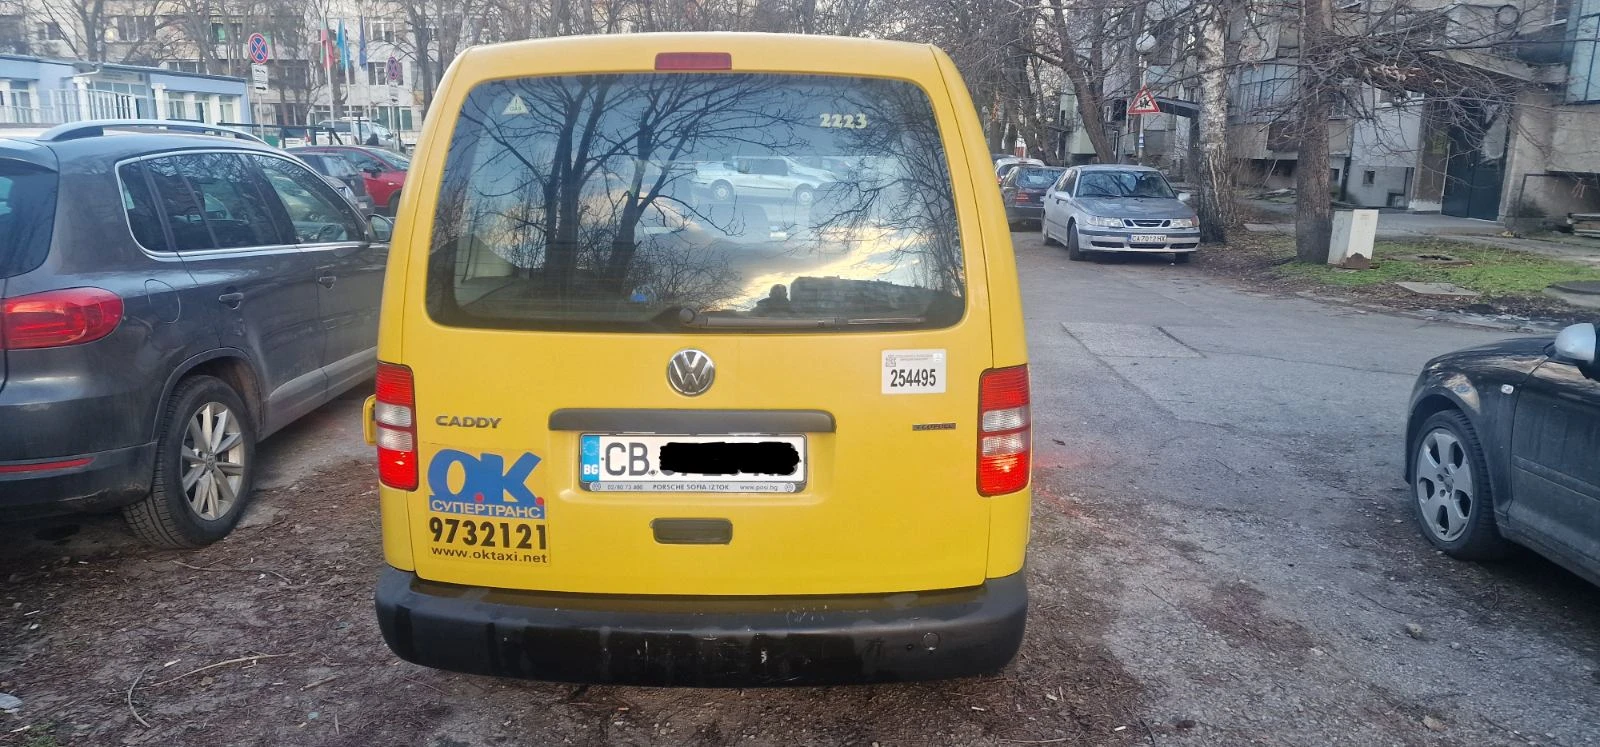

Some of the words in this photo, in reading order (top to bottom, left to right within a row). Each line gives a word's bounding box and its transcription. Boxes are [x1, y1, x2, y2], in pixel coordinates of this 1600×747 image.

[820, 112, 868, 129] 2223
[890, 369, 936, 387] 254495
[435, 415, 502, 428] CADDY
[583, 464, 599, 475] BG
[431, 499, 541, 518] СУПЕРТРАНС
[429, 517, 547, 550] 9732121
[431, 547, 547, 563] www.oktaxi.net
